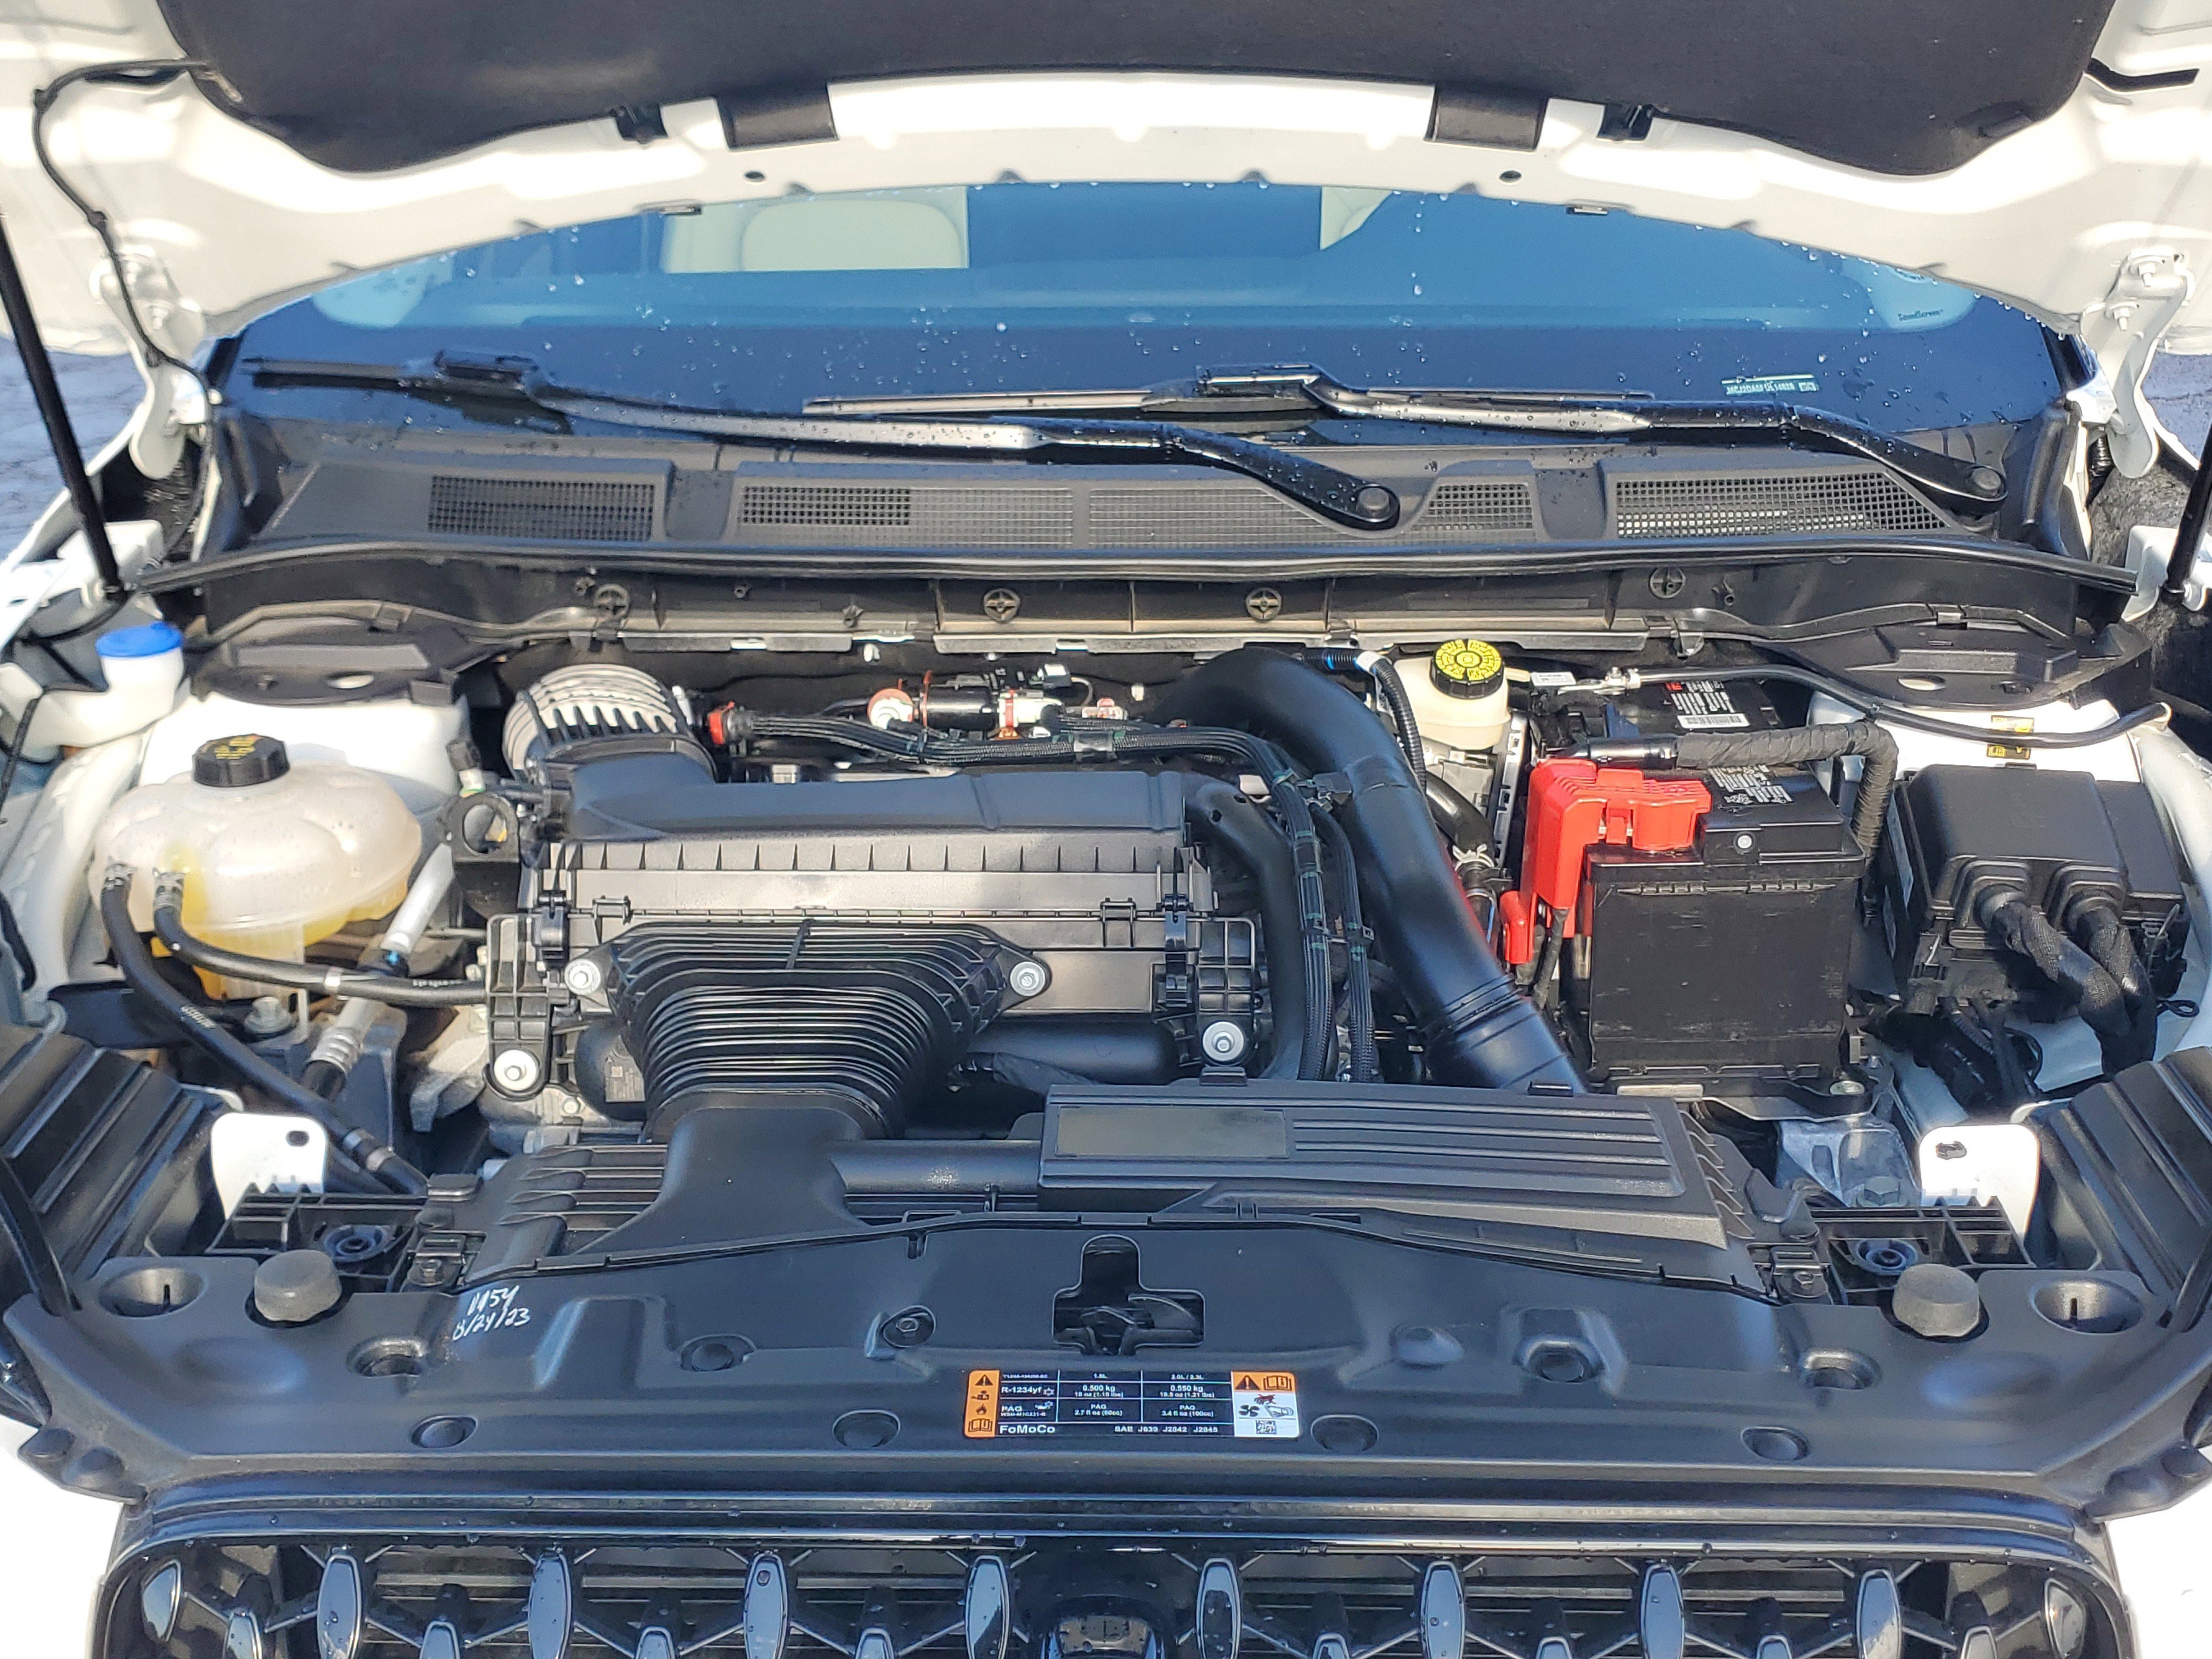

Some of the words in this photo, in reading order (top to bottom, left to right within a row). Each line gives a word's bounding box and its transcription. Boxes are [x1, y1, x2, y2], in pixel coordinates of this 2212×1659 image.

[1001, 1386, 1042, 1394] R-1234yf
[1105, 1384, 1116, 1393] kg
[1193, 1385, 1204, 1393] kg
[999, 1424, 1056, 1434] FoMoCo
